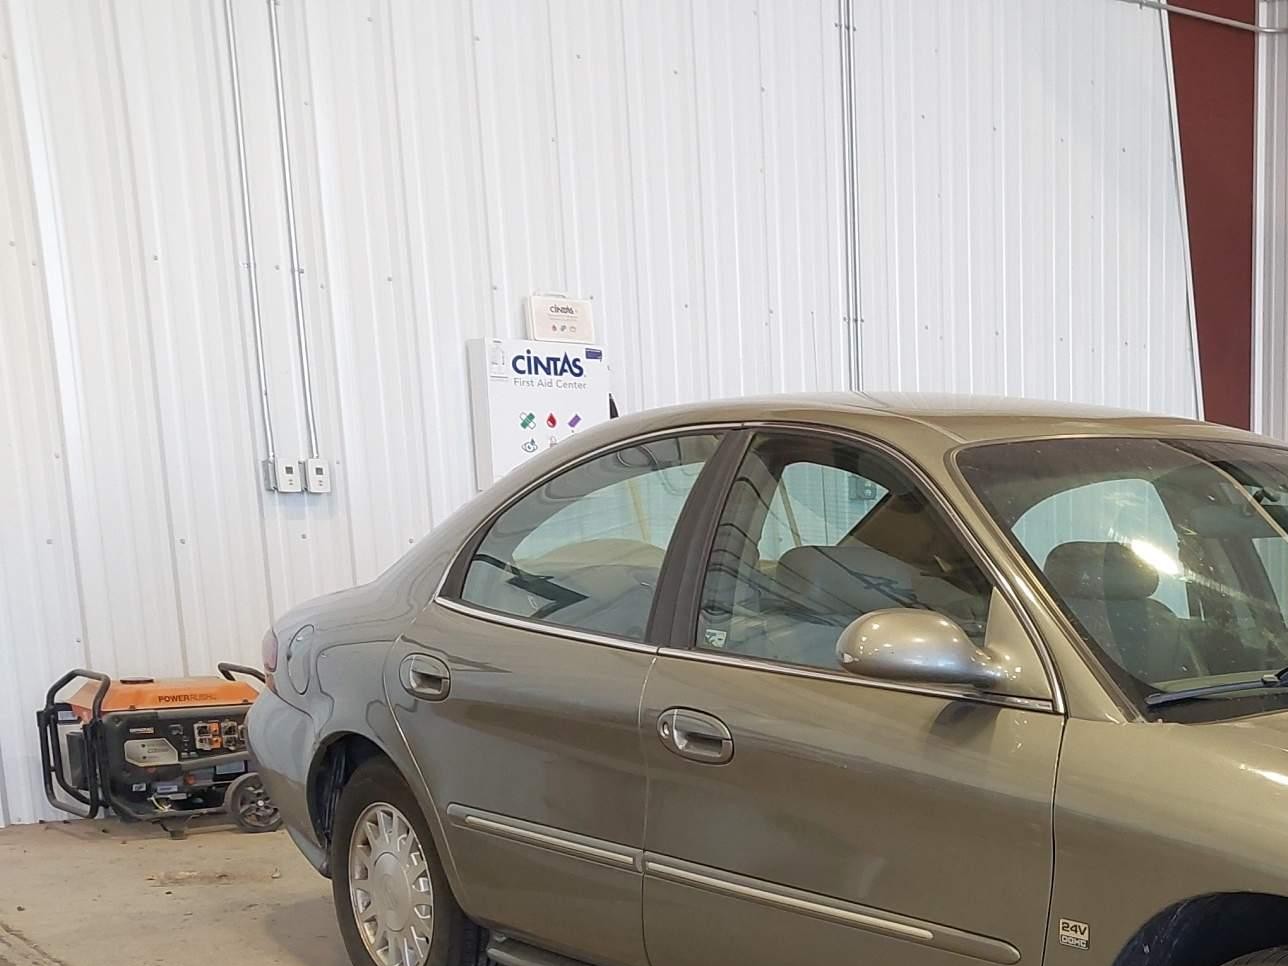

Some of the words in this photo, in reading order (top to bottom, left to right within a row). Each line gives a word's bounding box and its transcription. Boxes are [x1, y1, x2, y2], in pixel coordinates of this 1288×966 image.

[514, 378, 535, 387] First
[538, 379, 553, 388] Aid
[556, 380, 587, 389] Center
[1062, 921, 1087, 935] 24V
